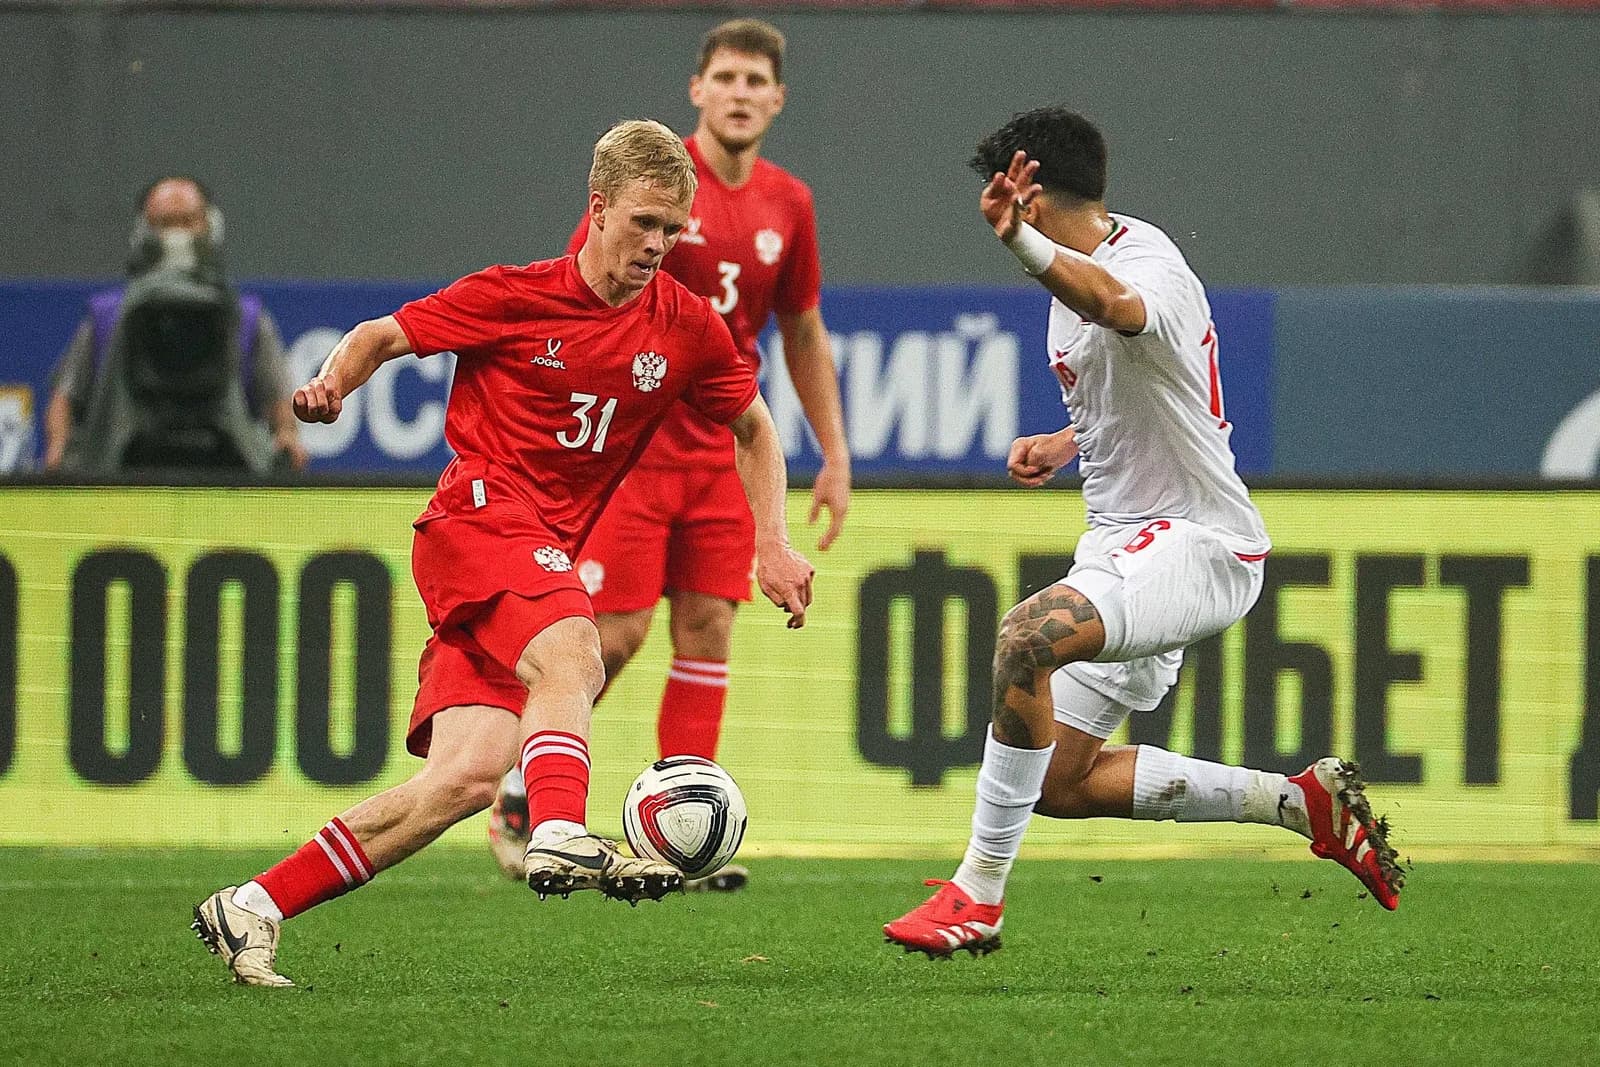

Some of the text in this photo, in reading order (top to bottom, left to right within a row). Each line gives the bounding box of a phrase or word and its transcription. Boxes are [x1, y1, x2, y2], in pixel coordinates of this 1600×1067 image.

[709, 261, 742, 314] 3
[556, 391, 618, 453] 31
[856, 549, 1531, 787] ФБЕТ
